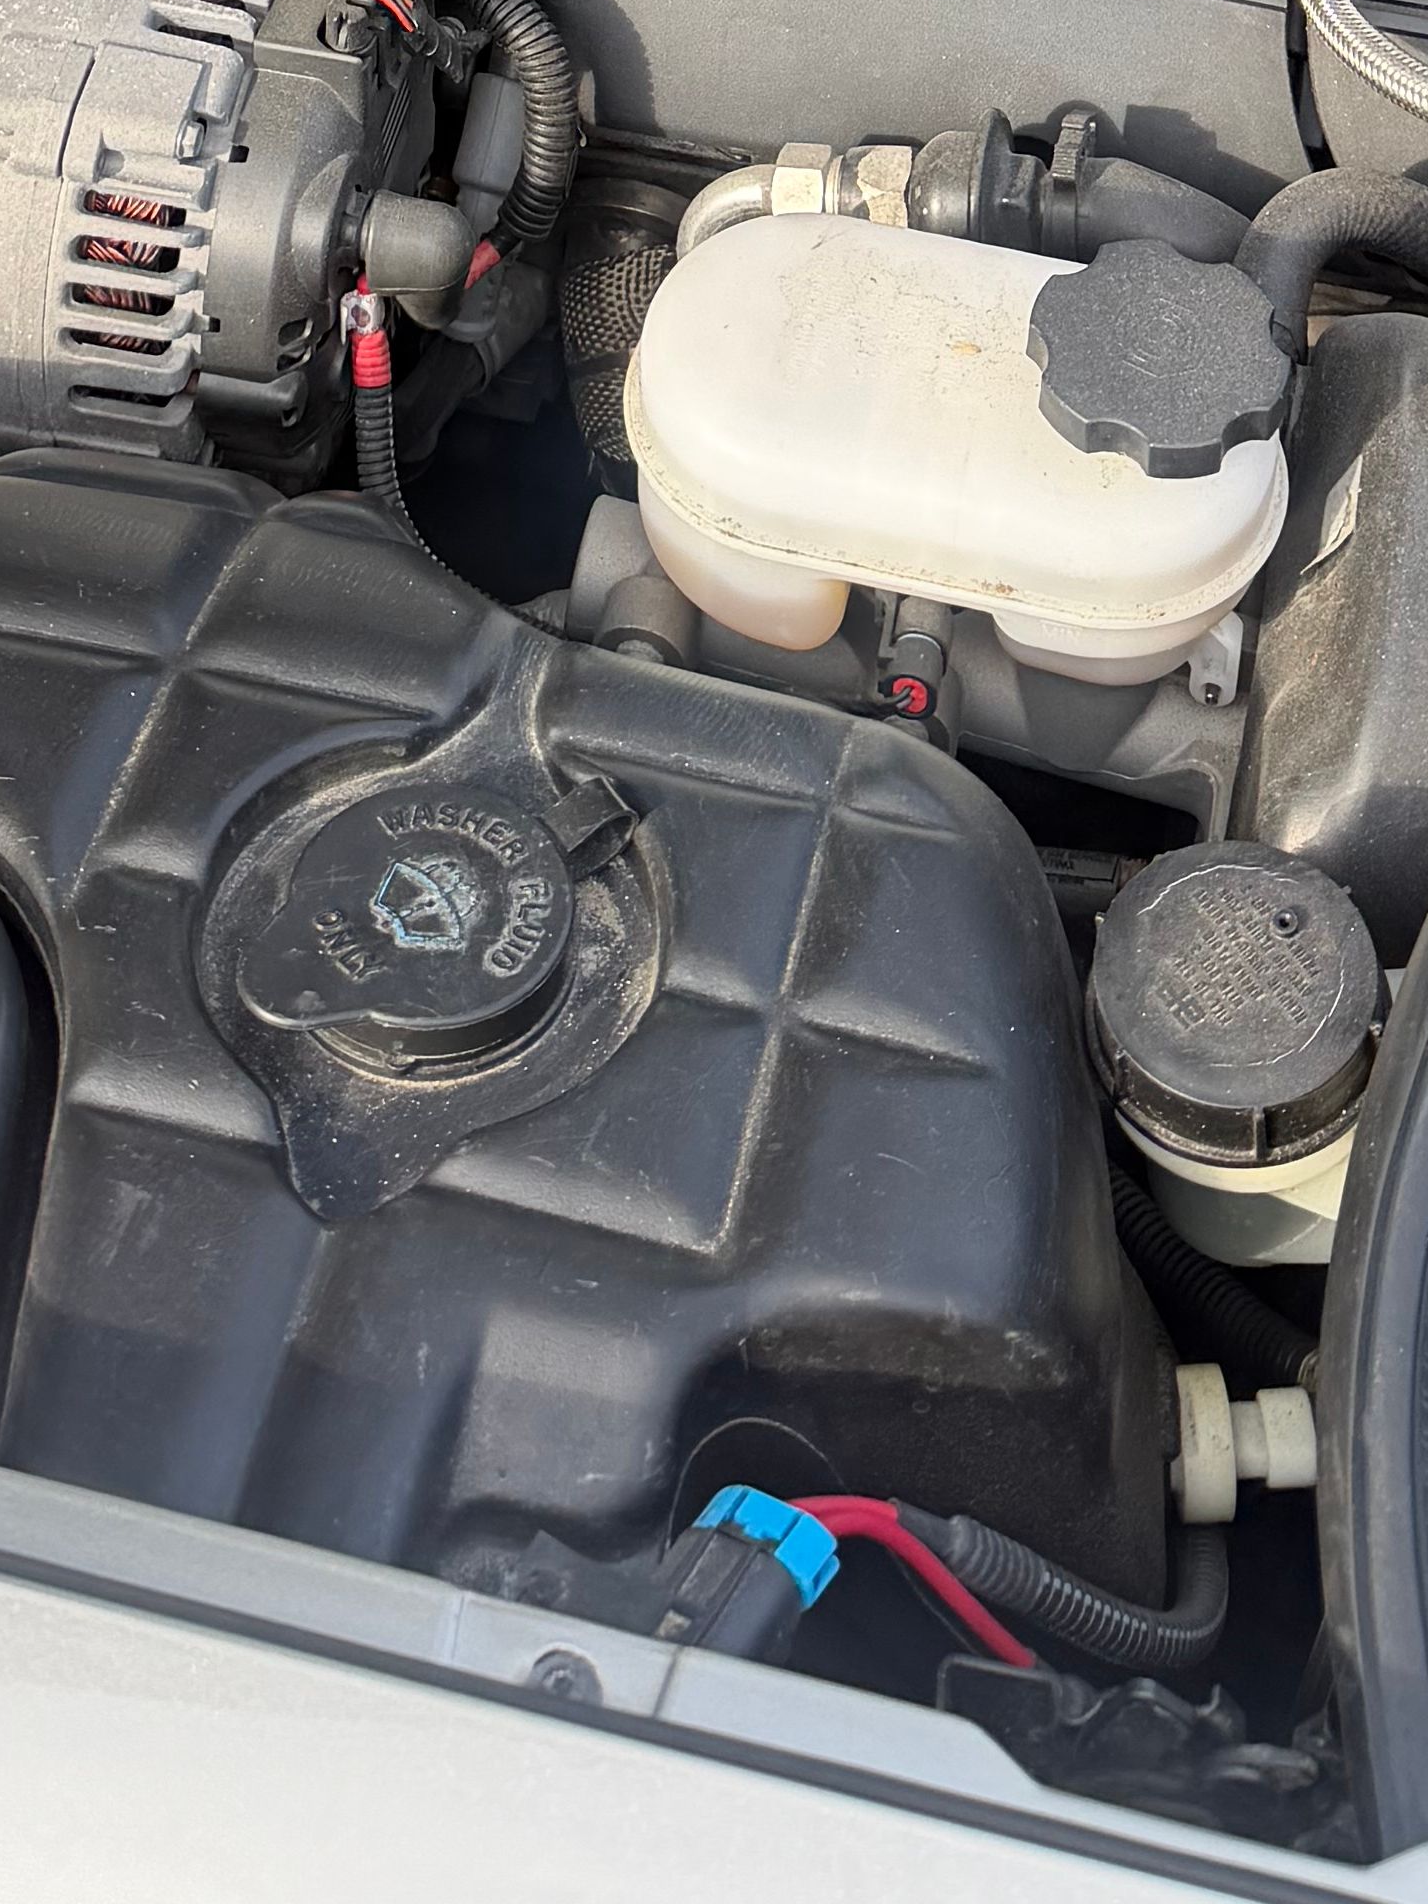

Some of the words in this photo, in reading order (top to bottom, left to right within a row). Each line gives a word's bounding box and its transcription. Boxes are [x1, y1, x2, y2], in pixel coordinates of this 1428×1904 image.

[378, 805, 528, 865] WASHER
[312, 909, 388, 981] ONLY
[484, 878, 552, 977] FLUID
